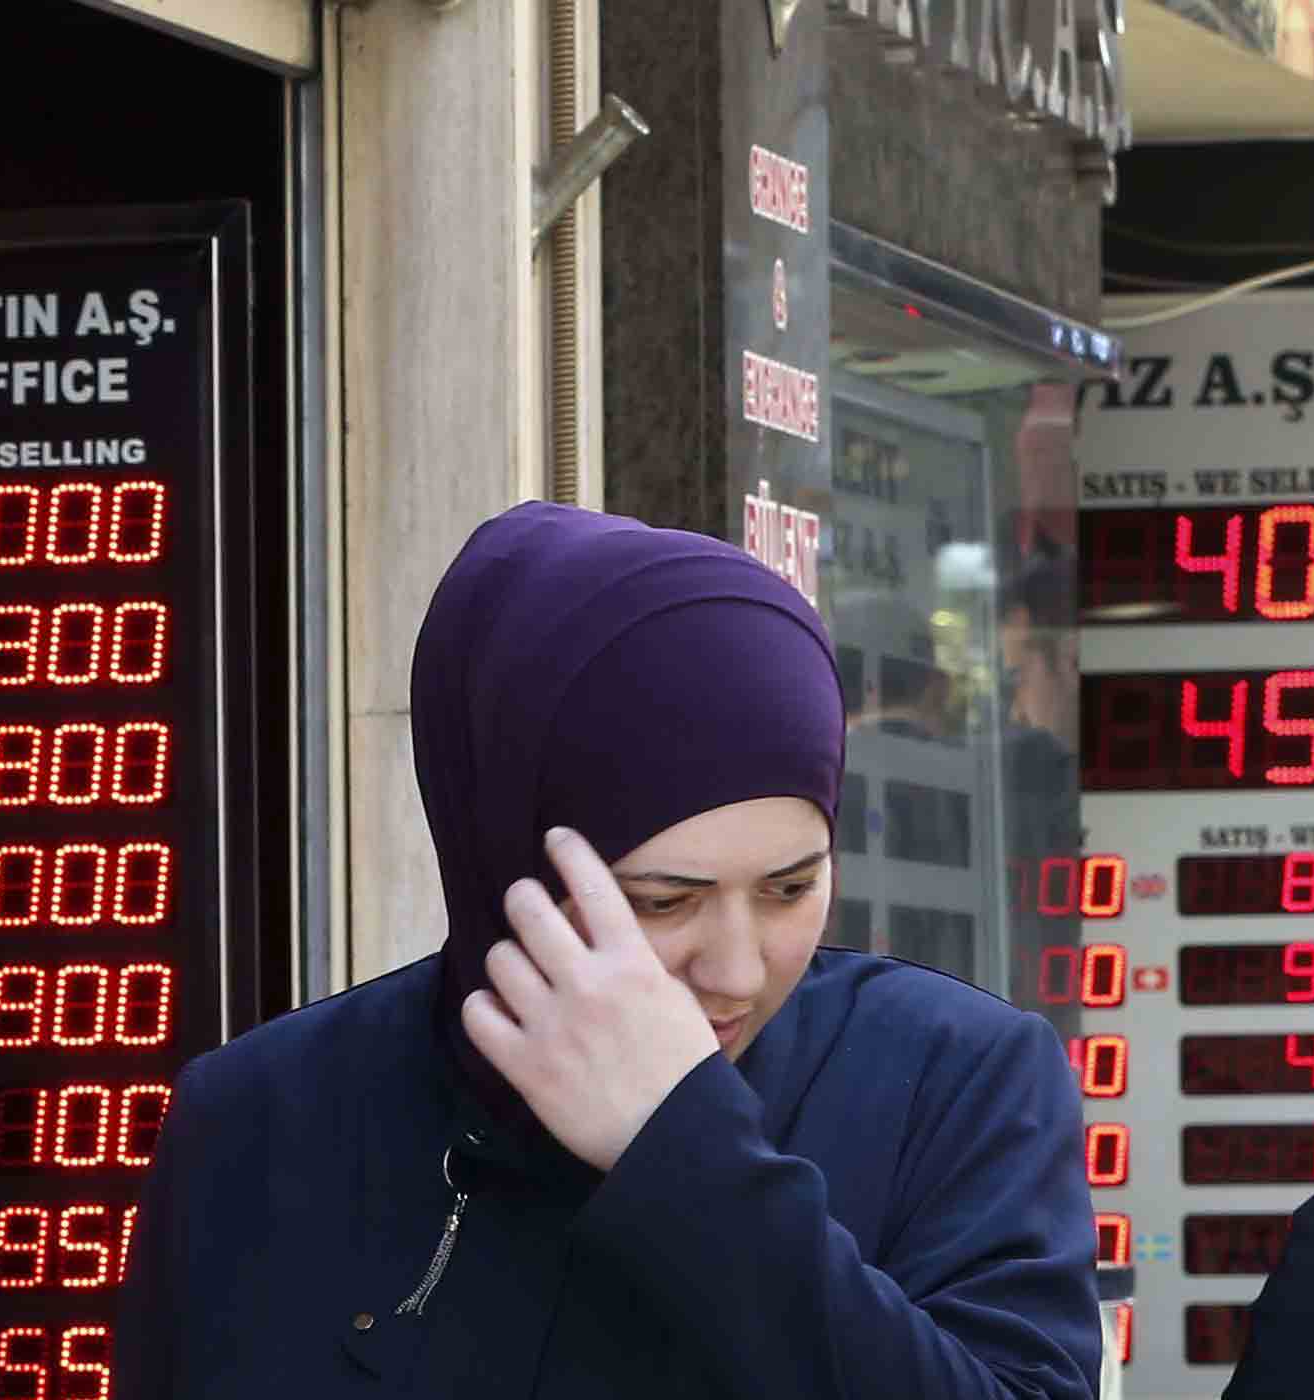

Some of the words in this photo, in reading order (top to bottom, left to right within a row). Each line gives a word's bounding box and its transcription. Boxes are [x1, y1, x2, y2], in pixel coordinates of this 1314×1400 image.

[74, 289, 176, 347] A.Ş.
[1083, 470, 1167, 503] SATIŞ
[1193, 469, 1241, 496] WE
[1200, 823, 1268, 853] SATIŞ
